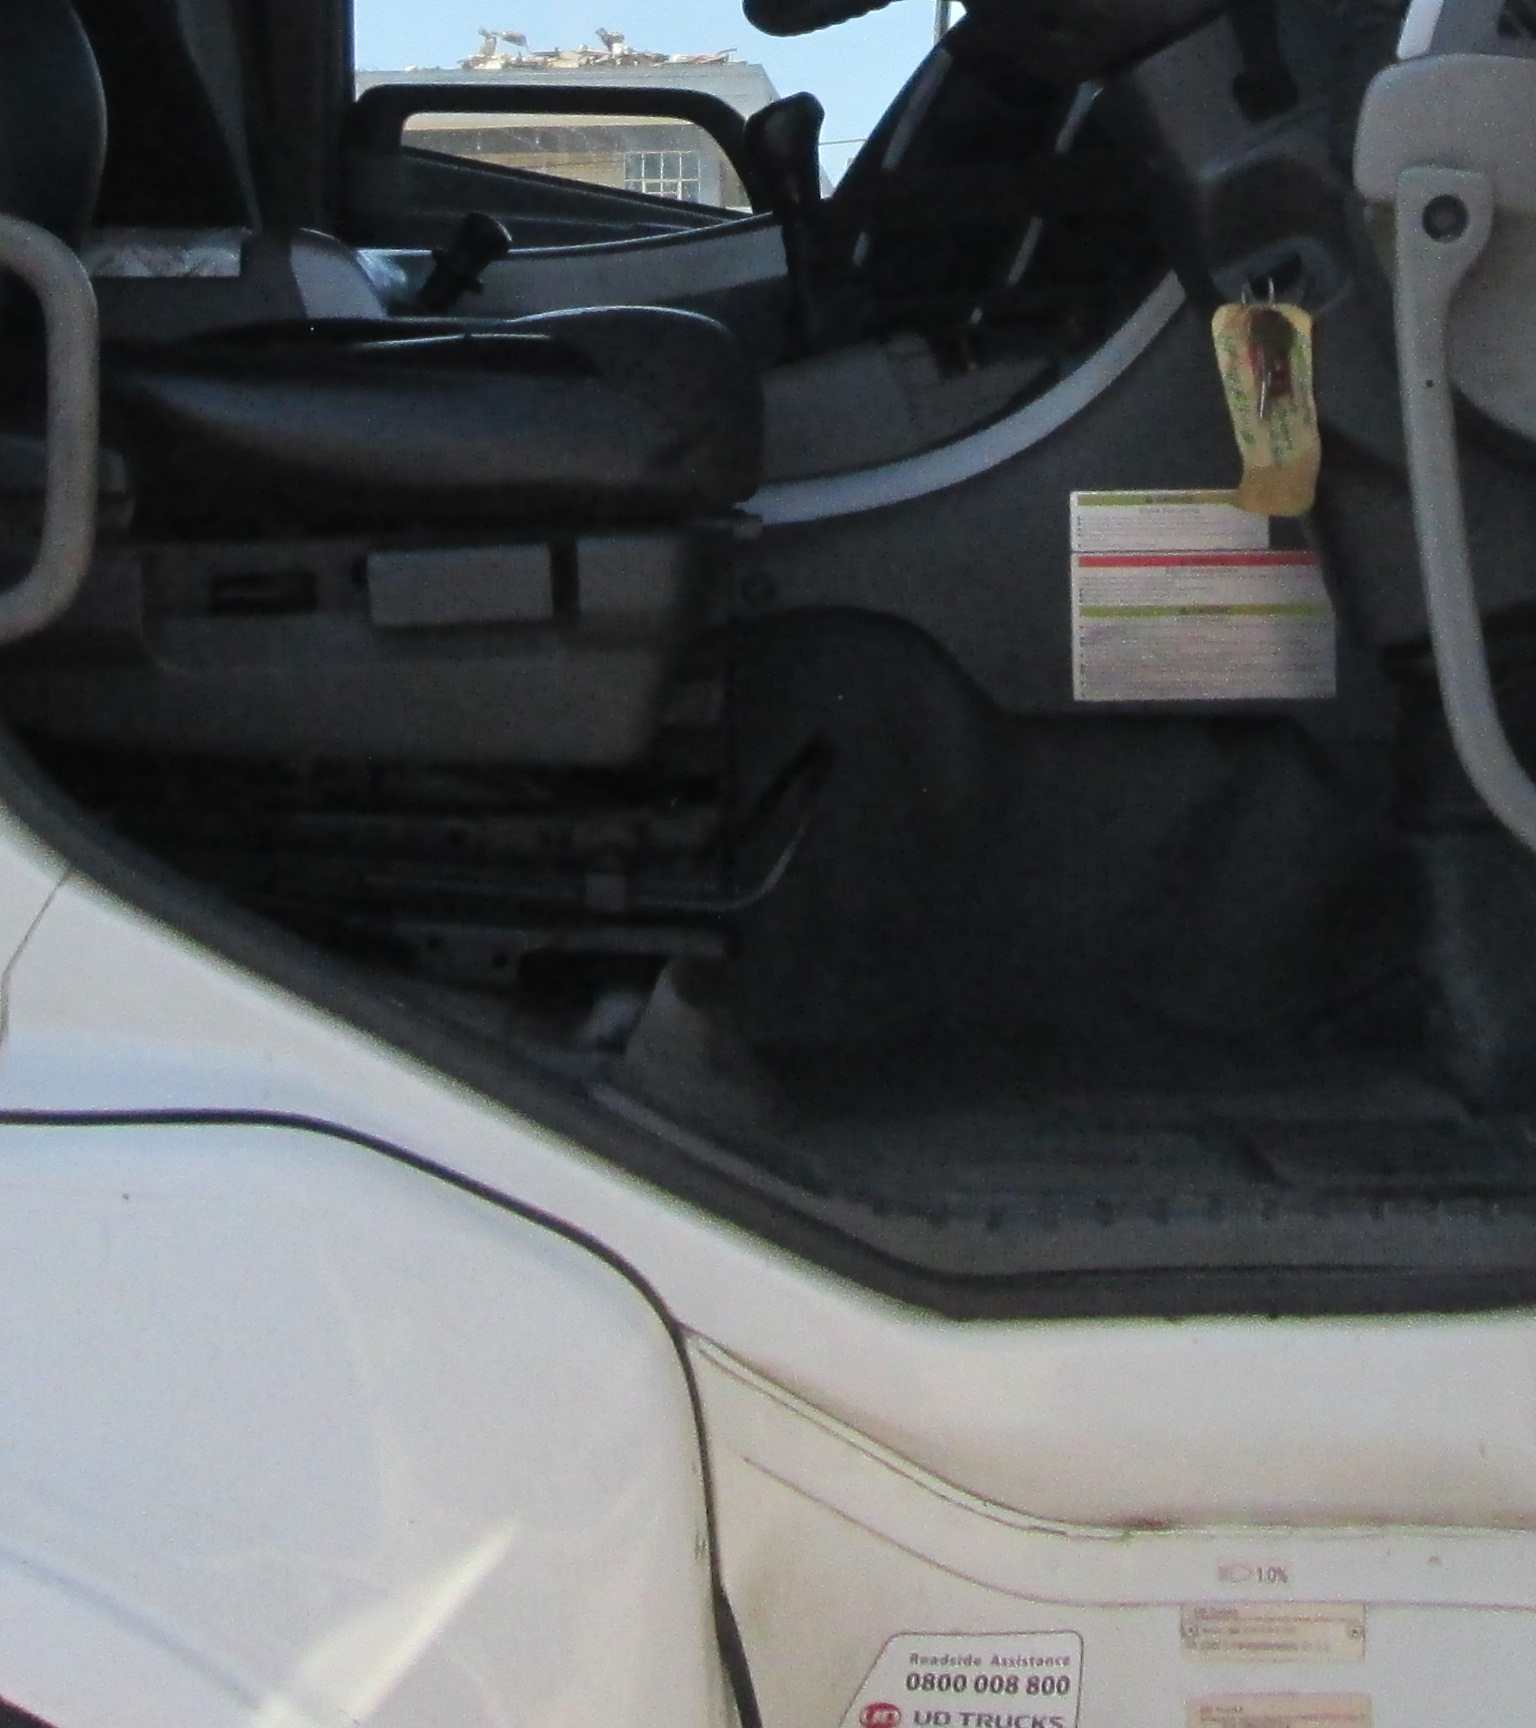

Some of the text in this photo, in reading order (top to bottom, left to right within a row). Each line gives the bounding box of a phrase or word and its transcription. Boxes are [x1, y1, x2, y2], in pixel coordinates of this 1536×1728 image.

[909, 1652, 1071, 1668] Roadside Assistance
[905, 1672, 1071, 1696] 0800 008 800
[913, 1710, 1064, 1728] UD TRUCKS
